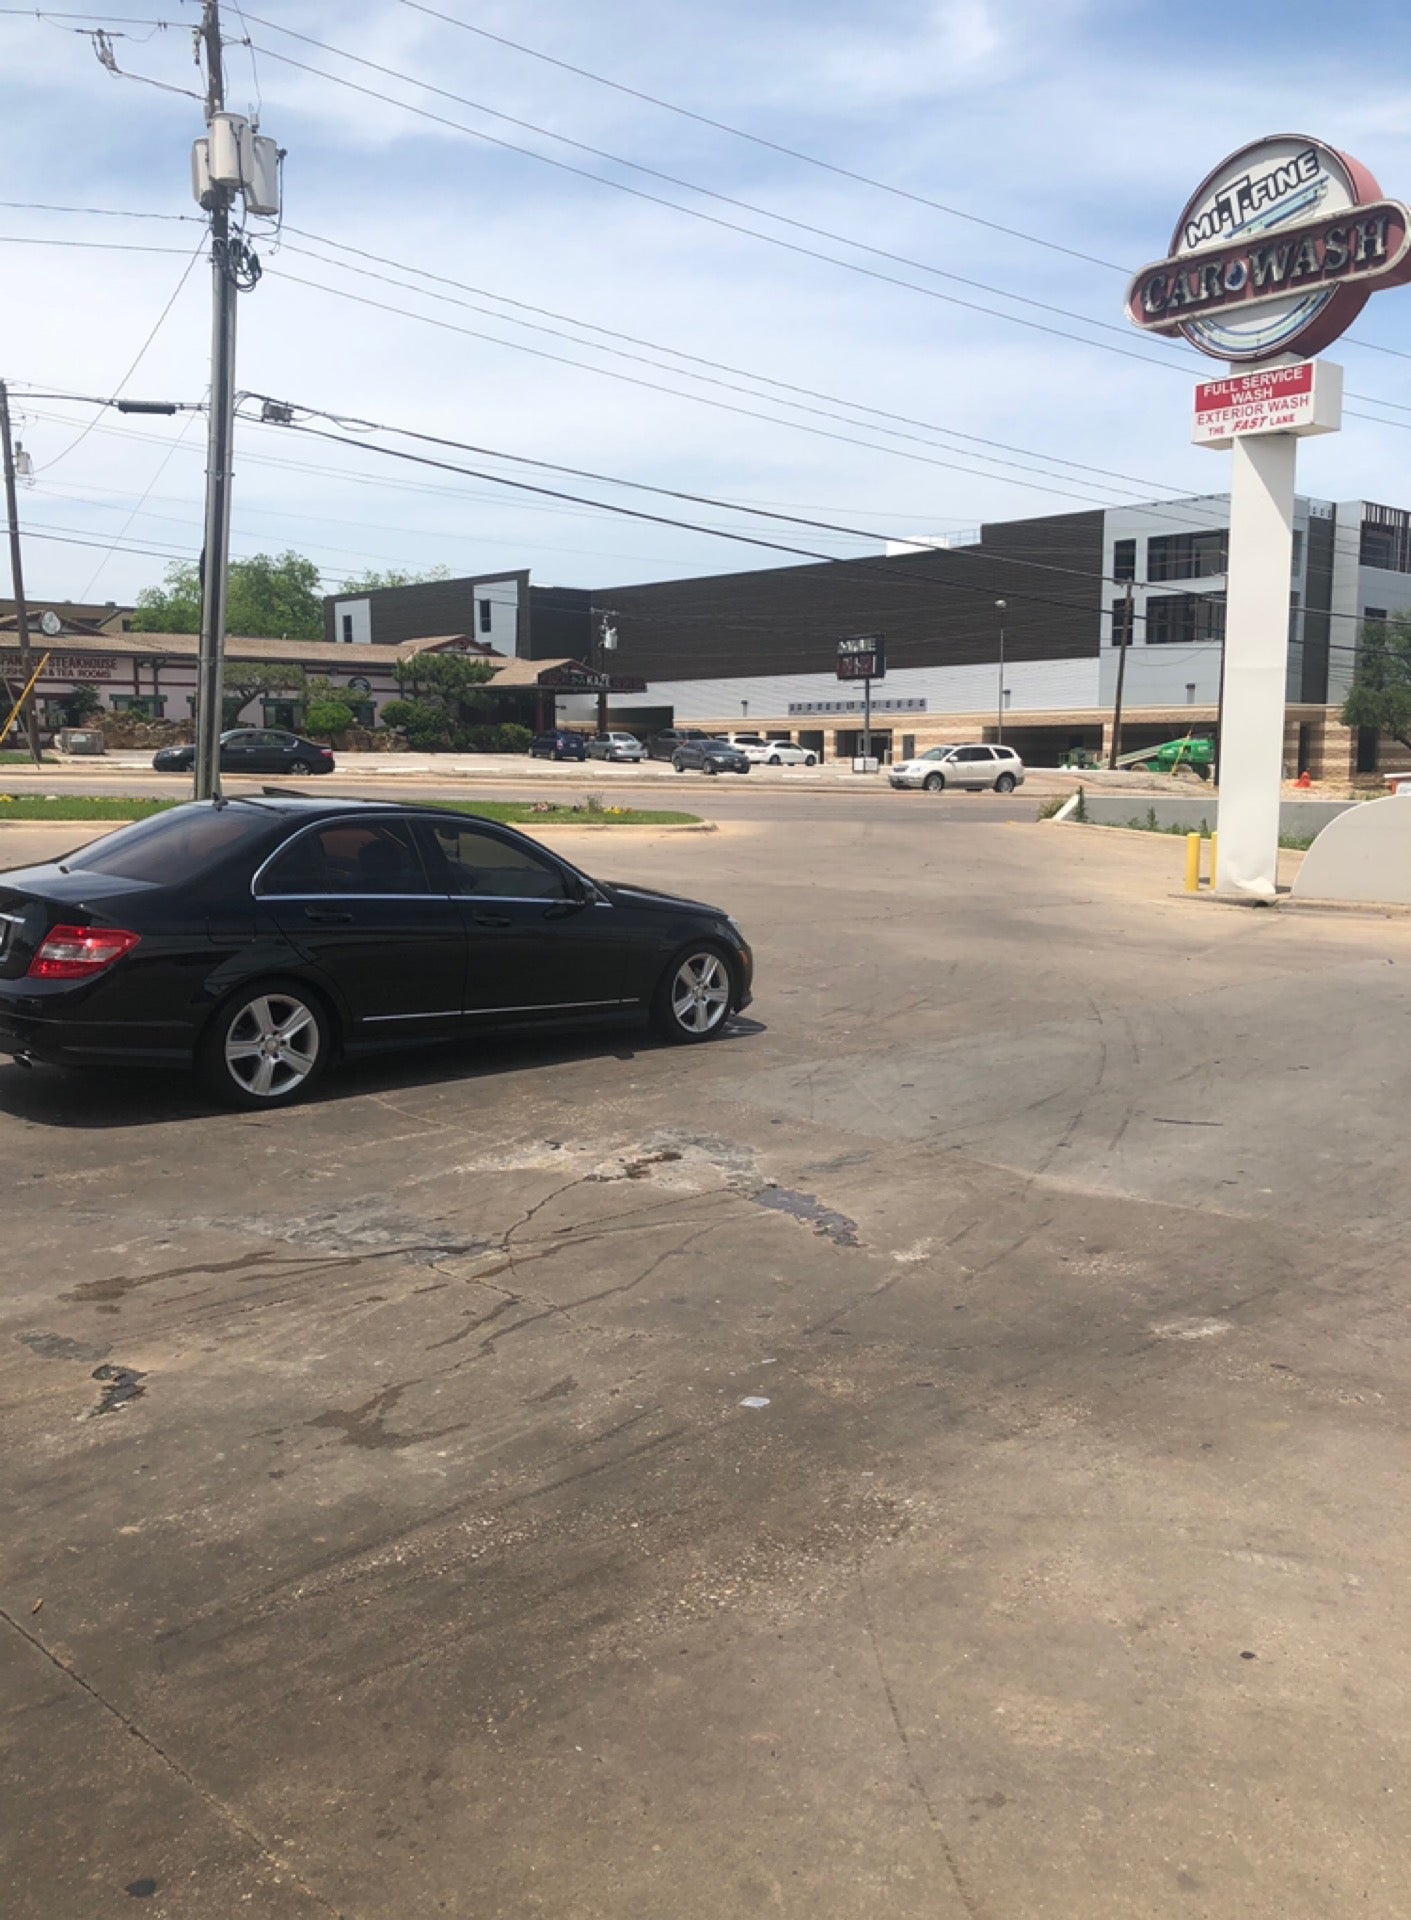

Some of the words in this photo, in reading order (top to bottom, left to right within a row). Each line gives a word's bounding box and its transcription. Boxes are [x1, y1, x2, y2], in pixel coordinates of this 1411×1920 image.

[1142, 261, 1225, 314] CAR
[1248, 214, 1388, 289] WASH
[1203, 380, 1238, 398] FULL
[1241, 367, 1303, 391] SERVICE
[1231, 386, 1272, 405] WASH
[1197, 404, 1263, 426] EXTERIOR
[1267, 395, 1309, 412] WASH
[1209, 426, 1225, 437] THE
[1231, 415, 1268, 432] FAST
[1269, 414, 1295, 426] LANE
[48, 656, 117, 670] STEAKHOUSE
